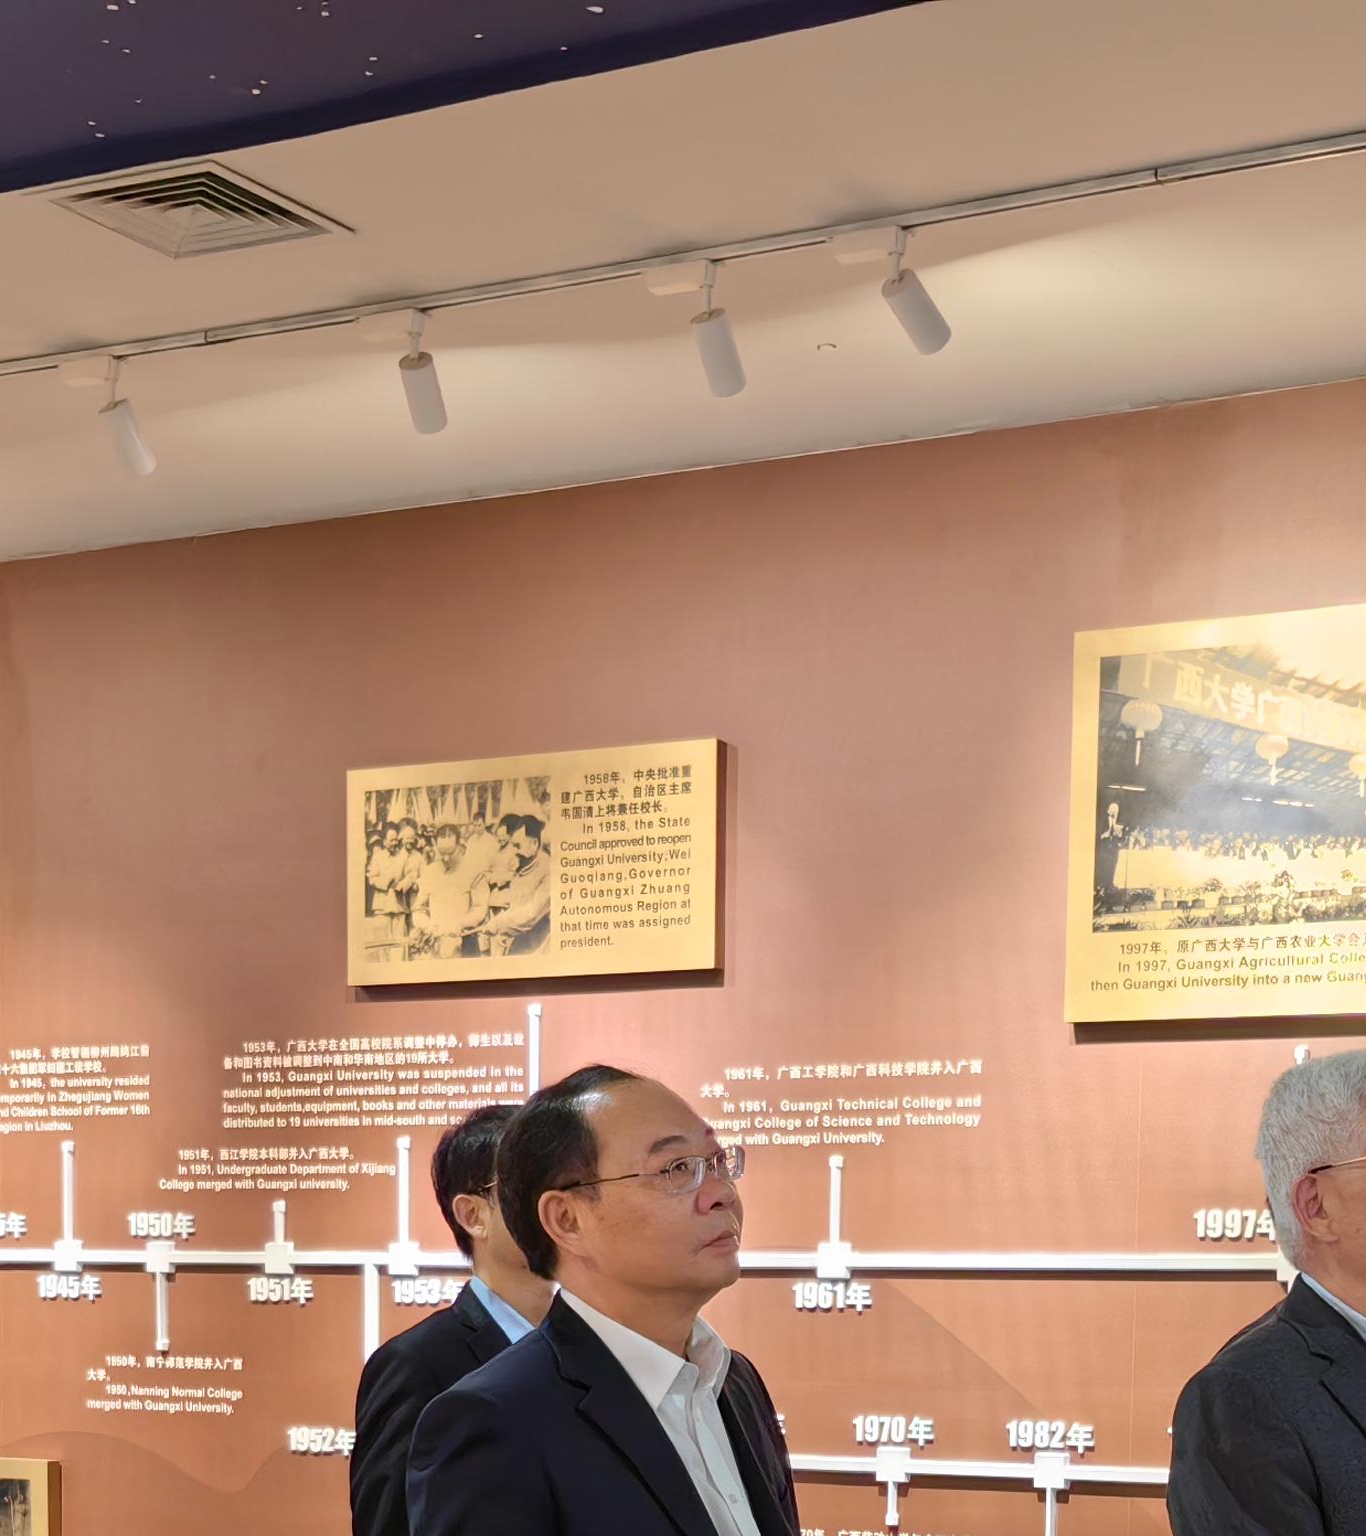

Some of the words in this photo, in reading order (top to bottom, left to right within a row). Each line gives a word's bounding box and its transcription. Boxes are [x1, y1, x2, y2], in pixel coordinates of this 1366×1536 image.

[583, 823, 594, 834] In
[634, 819, 654, 830] the
[658, 817, 690, 828] State
[560, 839, 597, 852] Council
[598, 836, 644, 850] approved
[645, 835, 656, 846] to
[657, 834, 692, 845] reopen
[560, 855, 604, 869] Guangxi
[560, 888, 574, 900] of
[579, 885, 634, 899] Guangxi
[640, 883, 690, 895] Zhuang
[560, 903, 633, 915] Autonomous
[637, 900, 677, 913] Region
[680, 898, 691, 909] at
[560, 921, 582, 932] that
[585, 921, 609, 931] time
[612, 919, 635, 929] was
[639, 914, 691, 929] assigned
[560, 936, 614, 949] president.
[1118, 961, 1130, 973] In
[1176, 958, 1234, 972] Guangxi
[1239, 954, 1324, 970] Agricultural
[1090, 980, 1119, 991] then
[1123, 978, 1177, 992] Guangxi
[1181, 975, 1249, 988] University
[1252, 974, 1279, 985] into
[1283, 975, 1290, 984] a
[1294, 974, 1323, 983] new
[177, 1163, 188, 1175] In
[216, 1163, 288, 1177] Undergraduate
[289, 1163, 347, 1176] Department
[347, 1162, 360, 1174] of
[361, 1163, 396, 1177] Xijiang
[158, 1178, 195, 1192] College
[196, 1178, 233, 1192] merged
[234, 1178, 255, 1190] with
[256, 1178, 298, 1192] Guangxi
[128, 1213, 195, 1239] 1950年
[38, 1275, 103, 1301] 1945年
[246, 1278, 314, 1305] 1951年
[792, 1281, 873, 1312] 1961年
[853, 1415, 934, 1446] 1970年
[1006, 1421, 1095, 1454] 1982年
